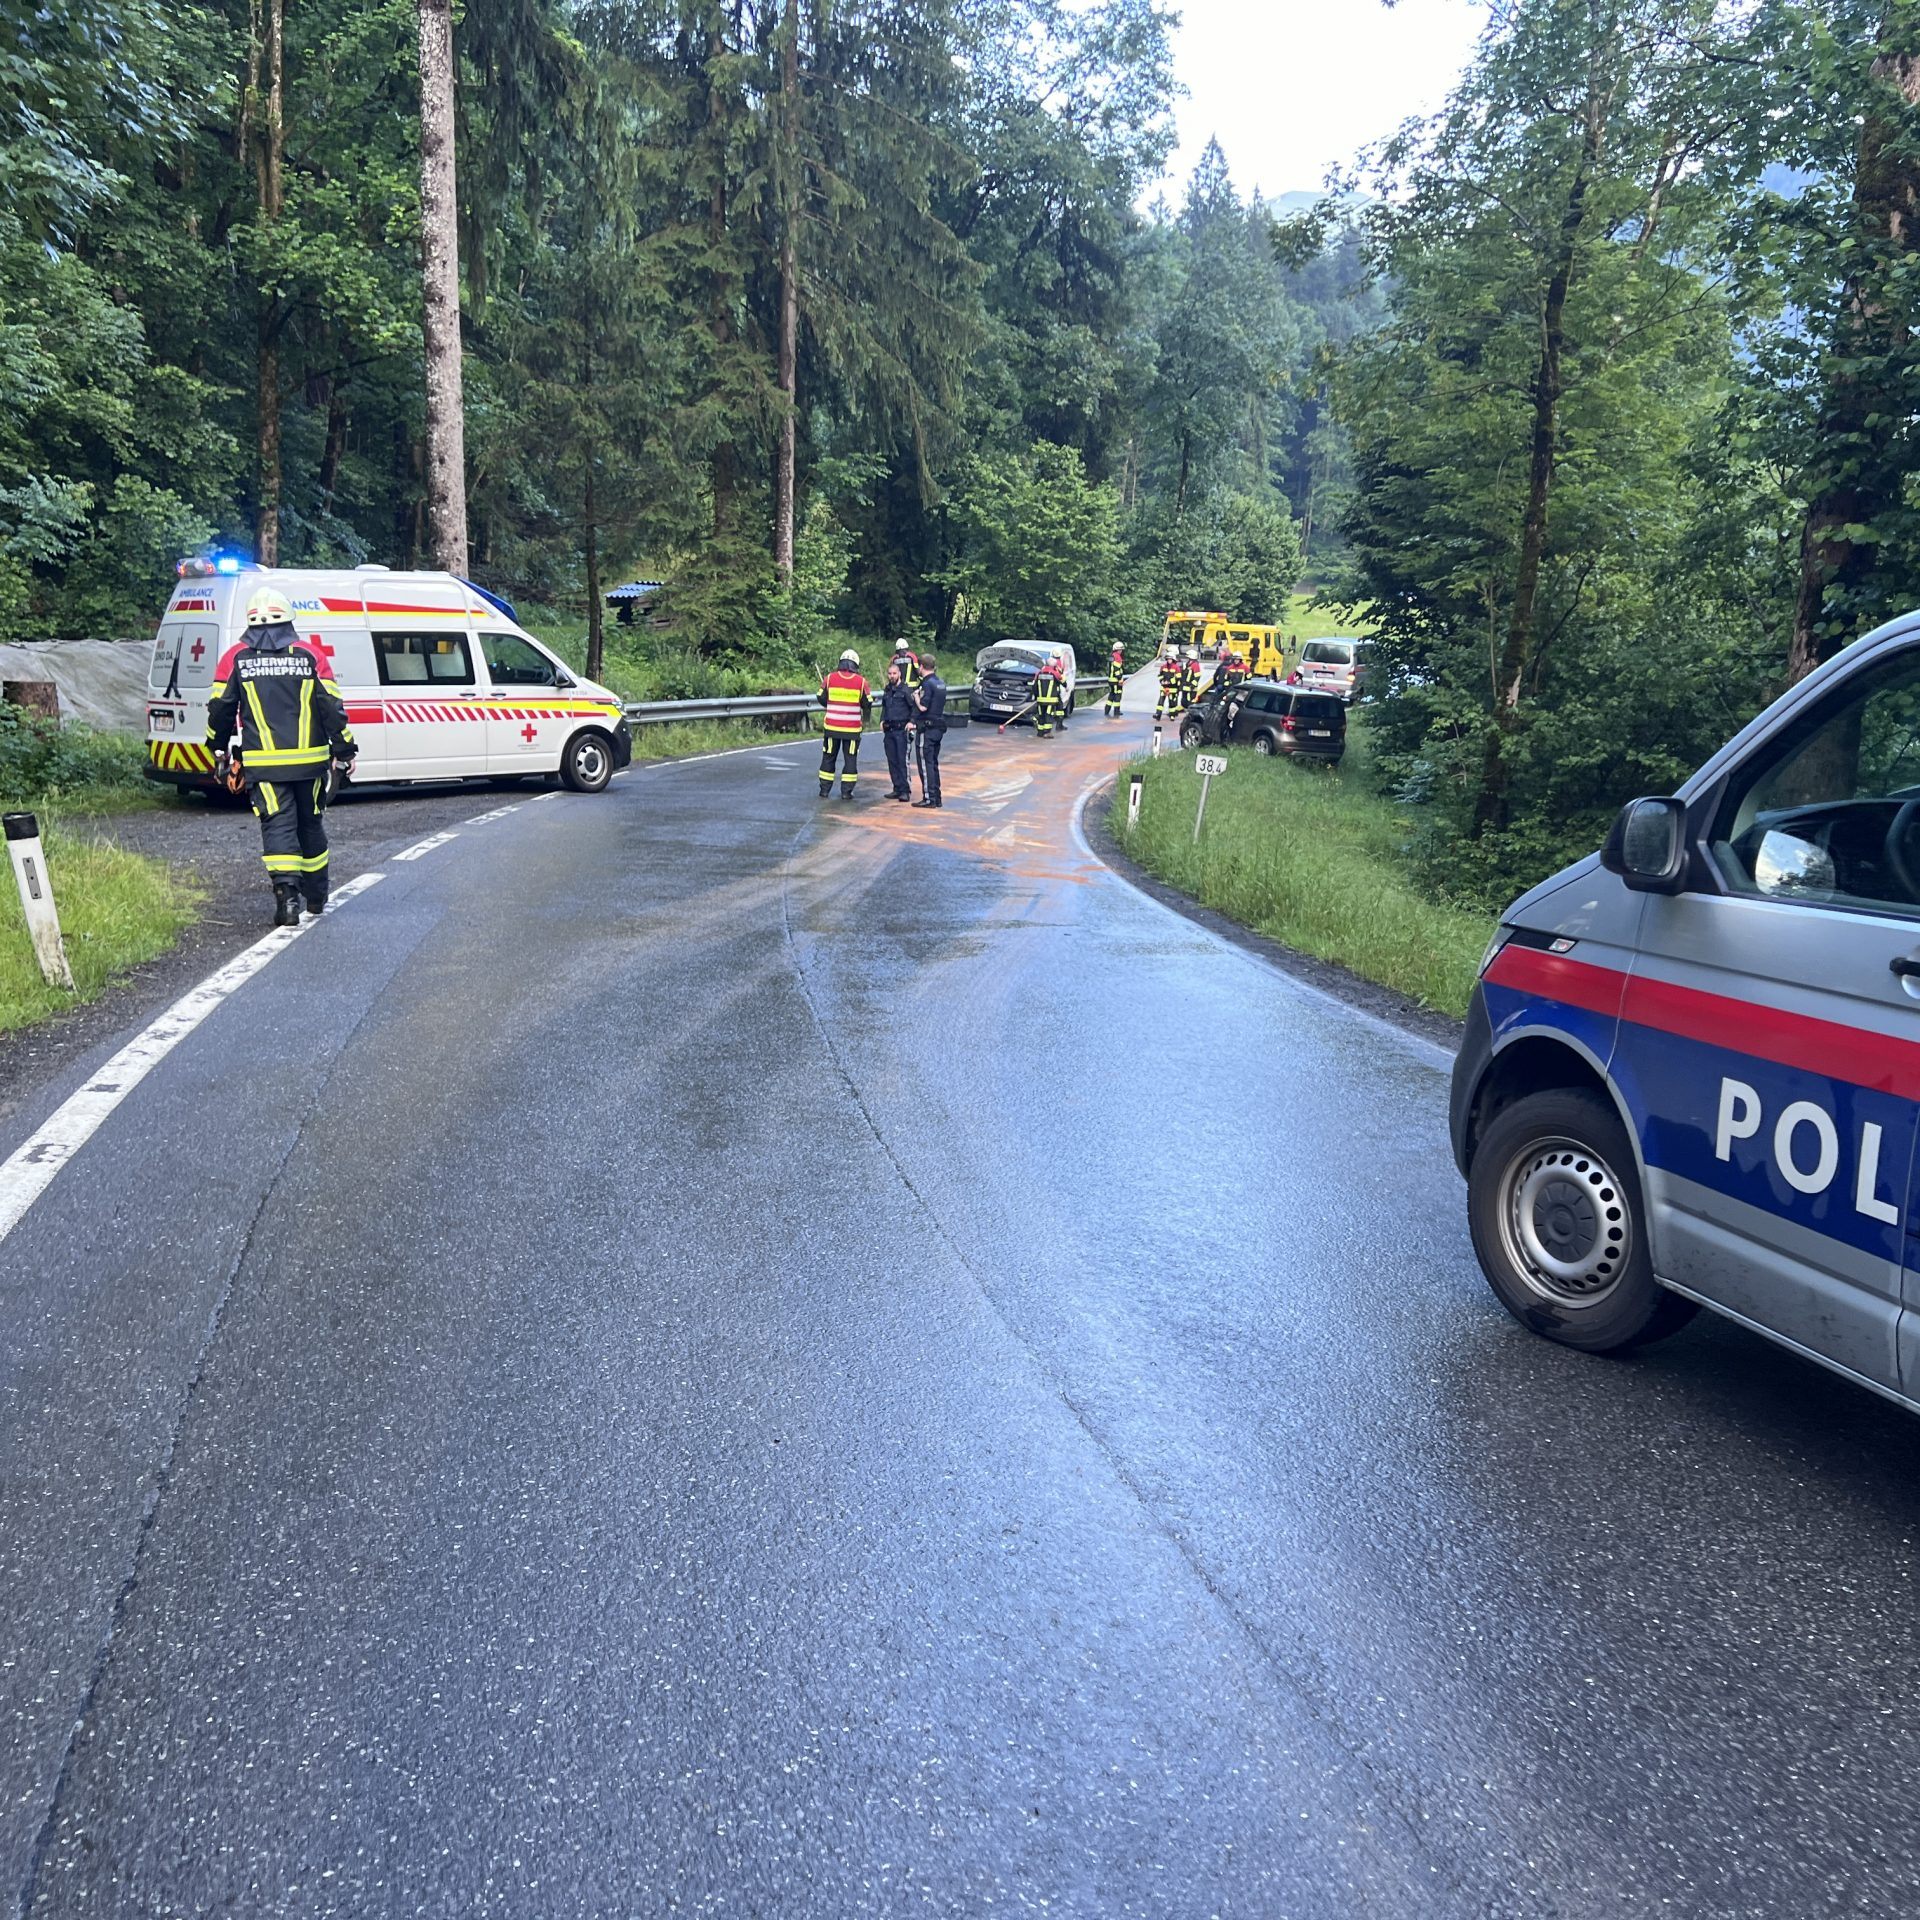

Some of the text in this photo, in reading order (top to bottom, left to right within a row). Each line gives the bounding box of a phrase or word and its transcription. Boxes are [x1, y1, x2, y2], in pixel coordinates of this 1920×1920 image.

[179, 587, 214, 597] AMBULANCE
[240, 666, 312, 678] SCHNEPFAU
[1715, 1076, 1899, 1226] POL
